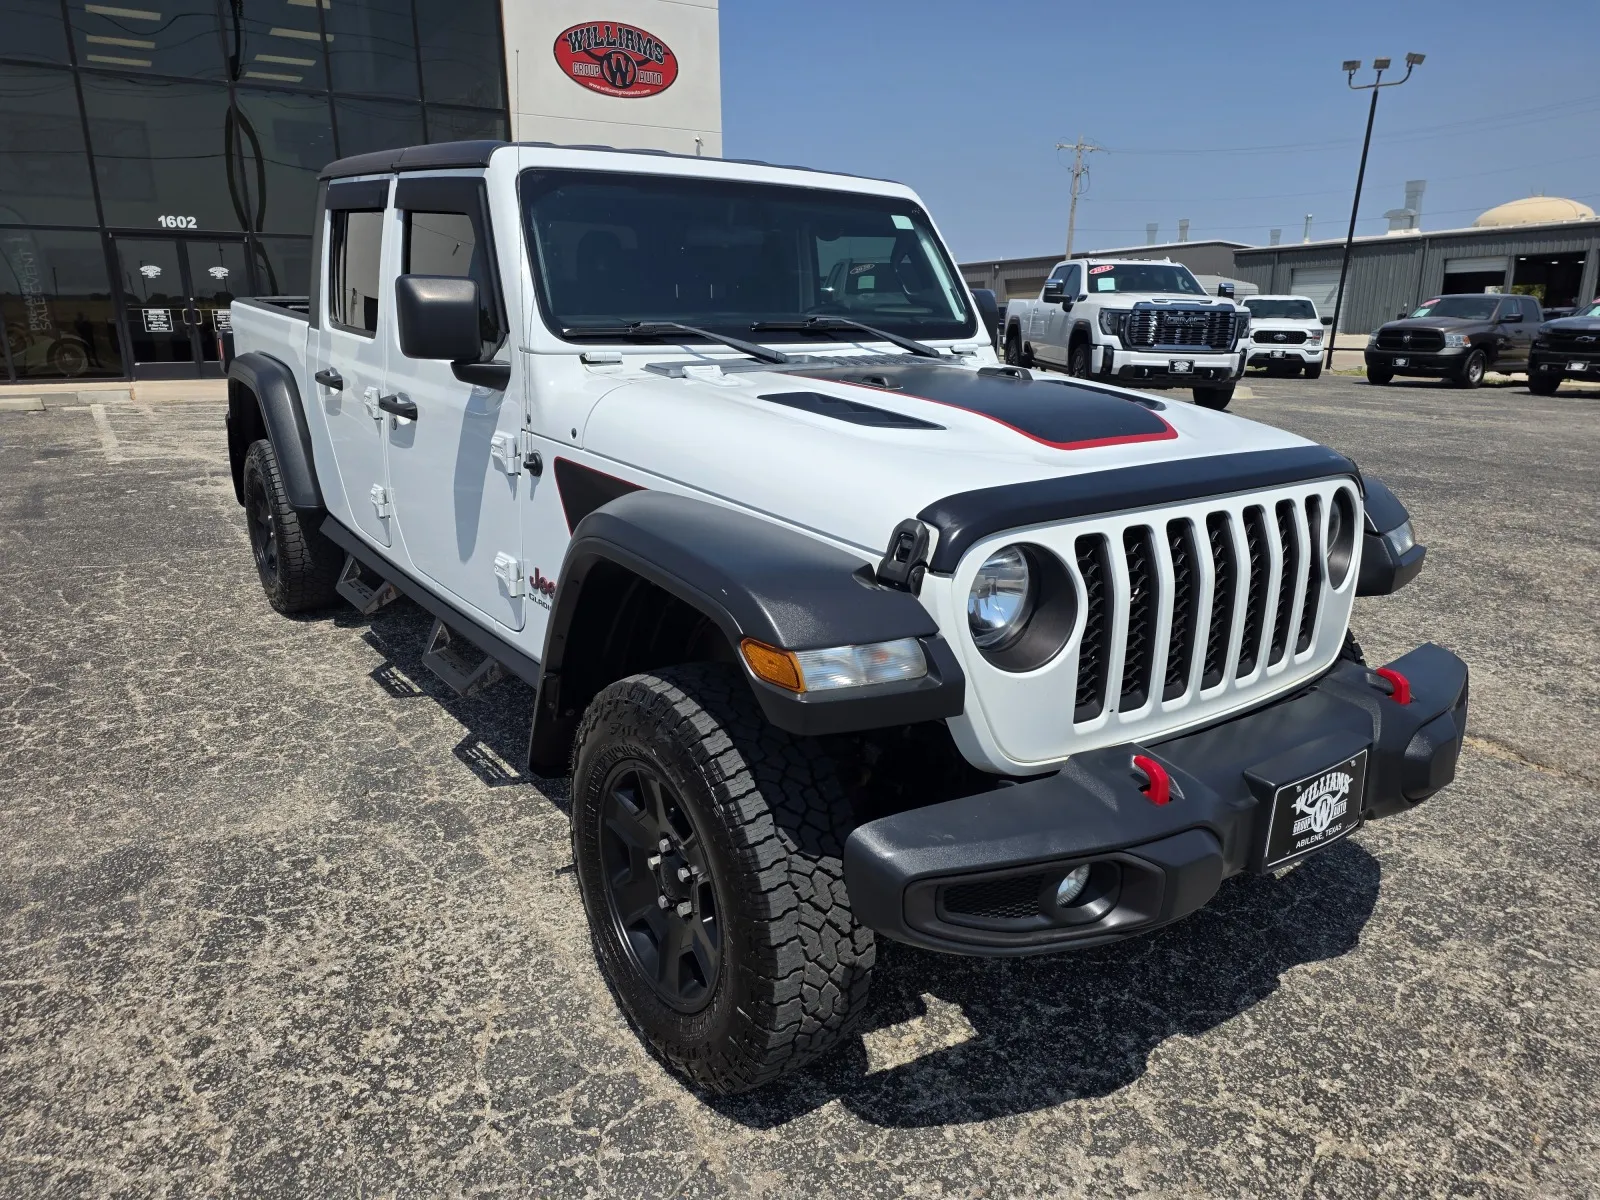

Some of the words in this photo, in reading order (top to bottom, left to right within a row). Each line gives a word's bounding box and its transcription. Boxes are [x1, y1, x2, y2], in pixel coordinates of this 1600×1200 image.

[567, 25, 664, 65] WILLIAMS
[573, 62, 600, 77] GROUP
[639, 70, 662, 85] AUTO
[158, 215, 197, 228] 1602
[20, 249, 42, 294] EVENT
[35, 297, 52, 331] SALE
[1167, 316, 1206, 325] GMC
[529, 567, 556, 600] Jee
[528, 592, 552, 611] GLADI
[1295, 772, 1350, 815] WILLIAMS
[1293, 817, 1311, 834] GROUP
[1333, 801, 1347, 817] AUTO
[1296, 832, 1325, 849] ABILENE,
[1325, 823, 1342, 837] TEXAS
